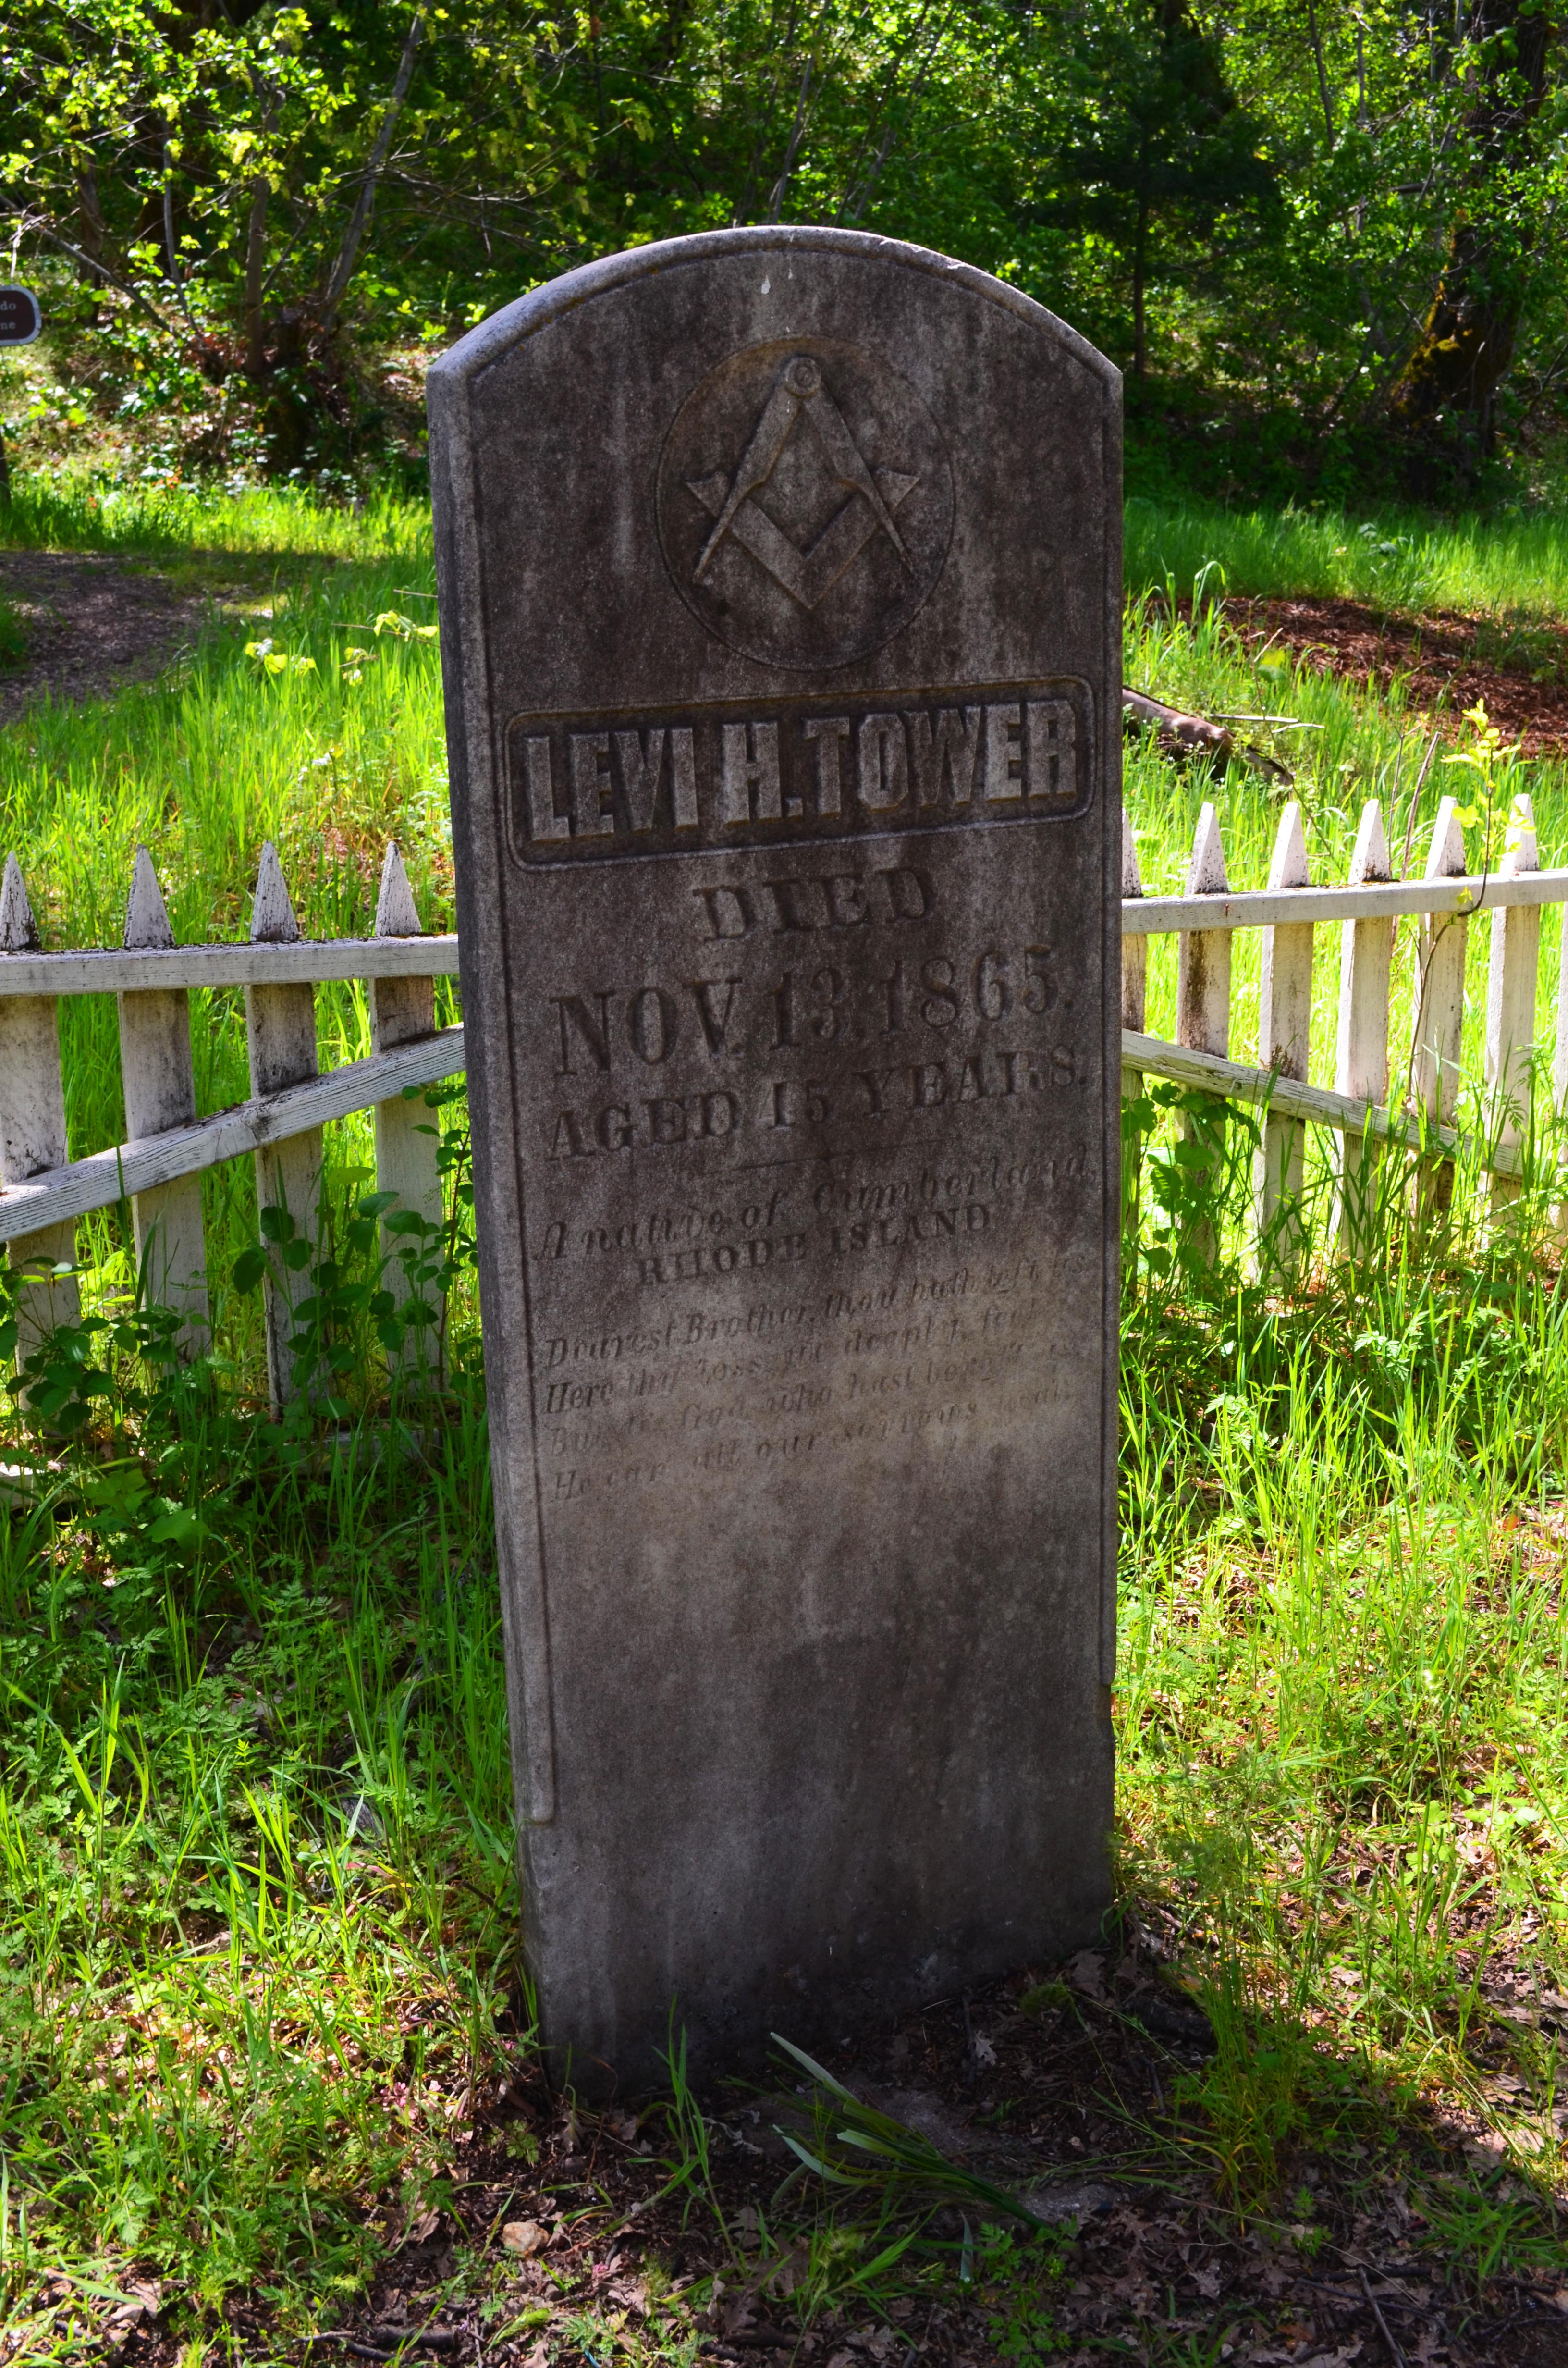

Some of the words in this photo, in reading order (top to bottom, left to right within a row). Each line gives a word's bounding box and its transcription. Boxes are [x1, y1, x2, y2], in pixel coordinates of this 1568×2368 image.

[527, 727, 699, 841] LEVI
[722, 721, 803, 824] H.
[804, 698, 1077, 815] TOWER
[693, 867, 937, 943] DIED
[545, 1091, 739, 1162] AGED
[532, 1221, 567, 1261] A
[580, 1205, 724, 1255] native
[741, 1190, 788, 1228] of
[633, 1232, 806, 1285] RHODE
[830, 1203, 990, 1254] ISLAND
[545, 1320, 677, 1368] Dearest
[825, 1290, 897, 1320] thou
[545, 1381, 613, 1414] Here
[555, 1469, 592, 1500] He
